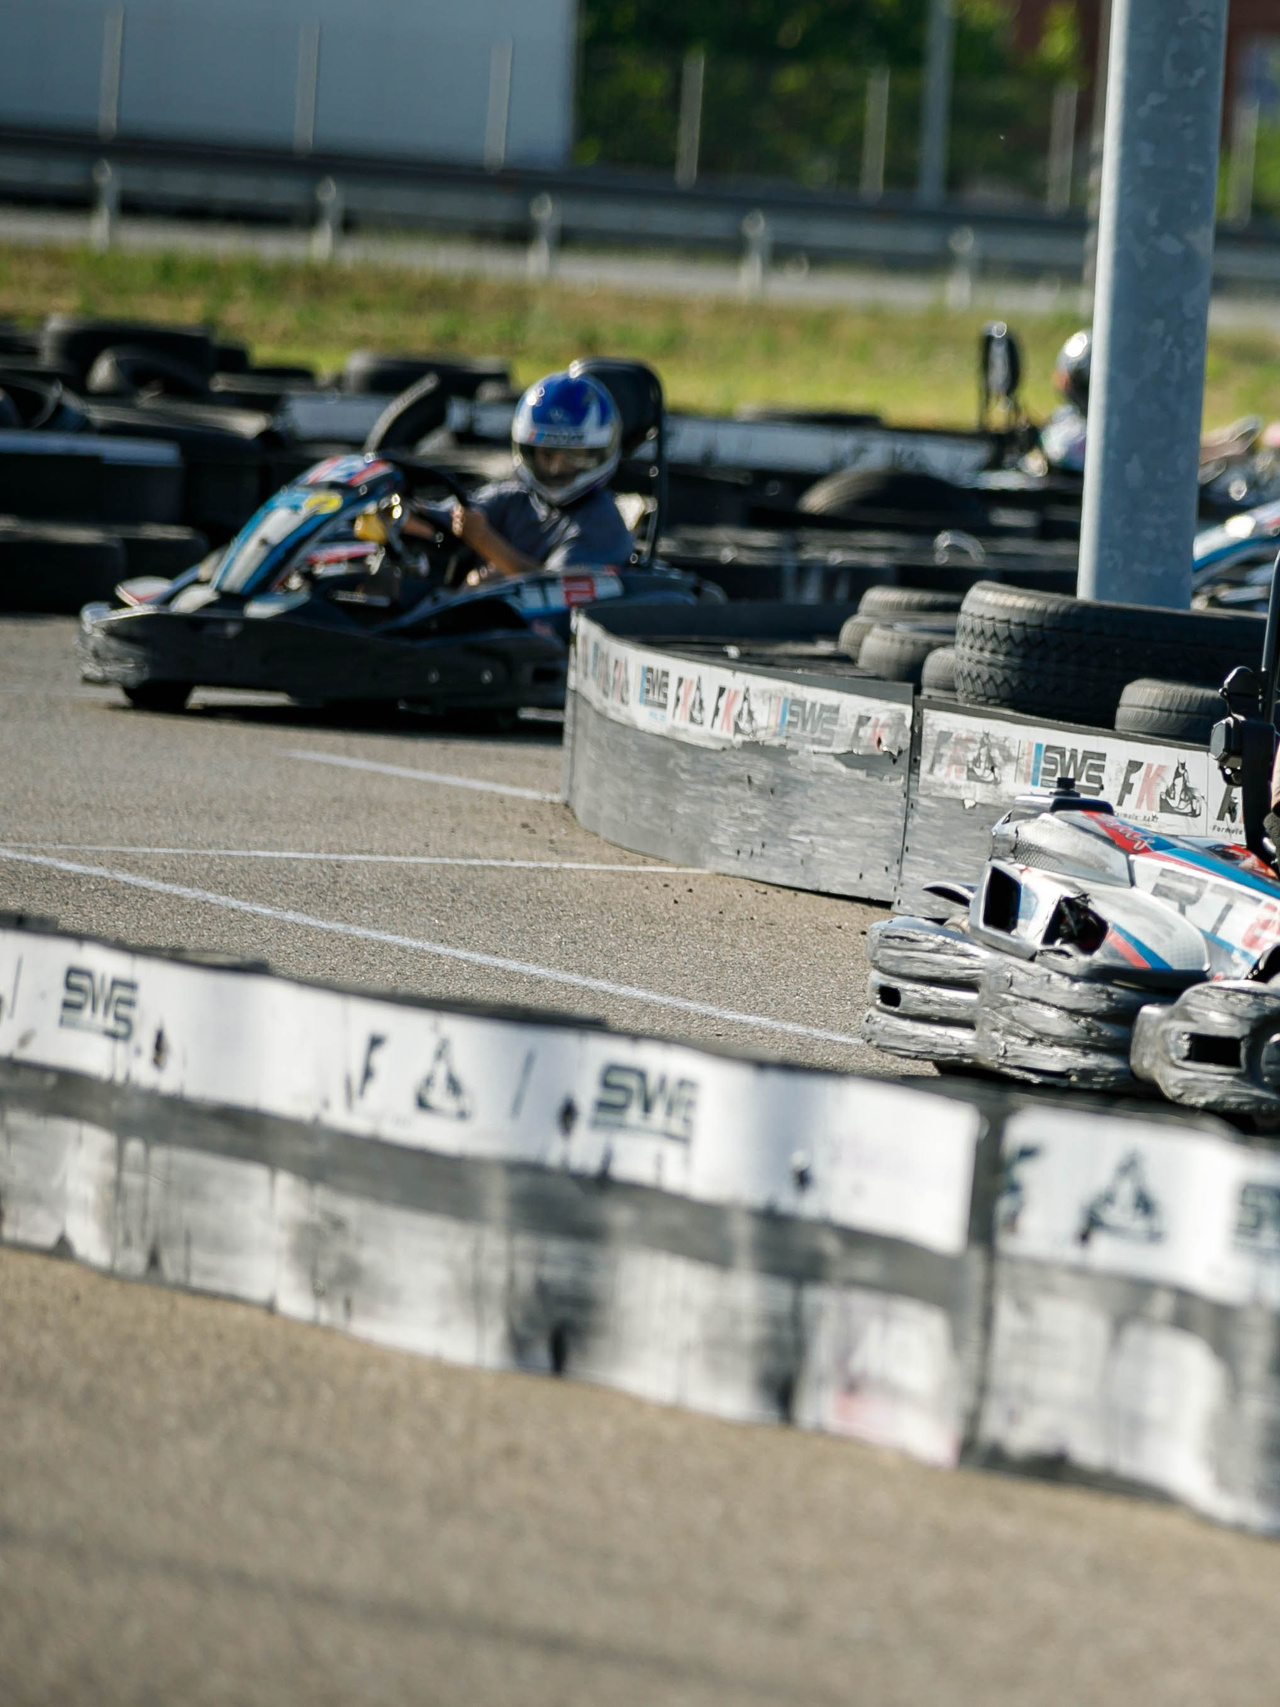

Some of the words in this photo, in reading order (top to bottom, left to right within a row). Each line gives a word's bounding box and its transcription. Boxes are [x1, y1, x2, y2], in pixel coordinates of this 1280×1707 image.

[711, 685, 740, 733] FK
[1041, 744, 1107, 796] SWS
[1117, 759, 1166, 812] FK
[60, 965, 138, 1043] SWS
